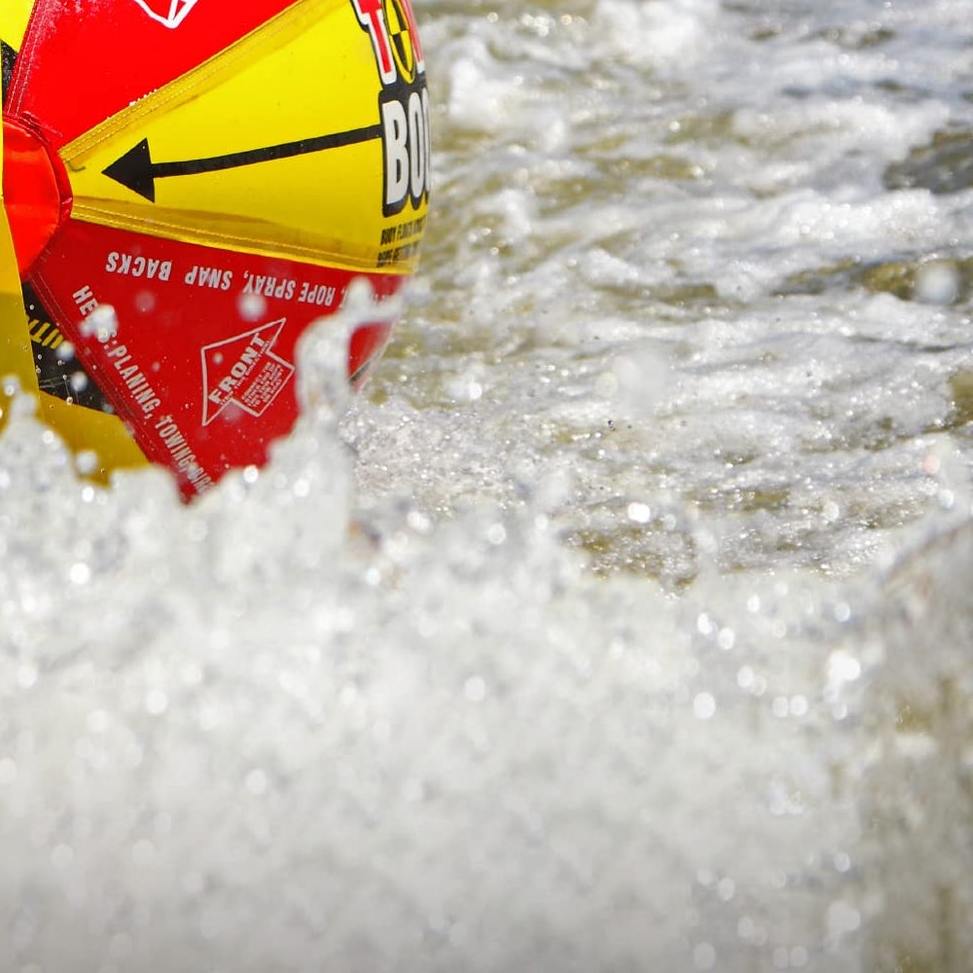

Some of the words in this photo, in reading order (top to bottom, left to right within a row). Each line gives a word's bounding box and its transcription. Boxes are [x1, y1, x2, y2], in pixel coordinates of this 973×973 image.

[105, 251, 173, 282] BACKS
[184, 265, 233, 291] SNAP
[242, 270, 296, 300] SPRAY,
[297, 281, 336, 307] ROPE
[209, 334, 269, 405] FRONT
